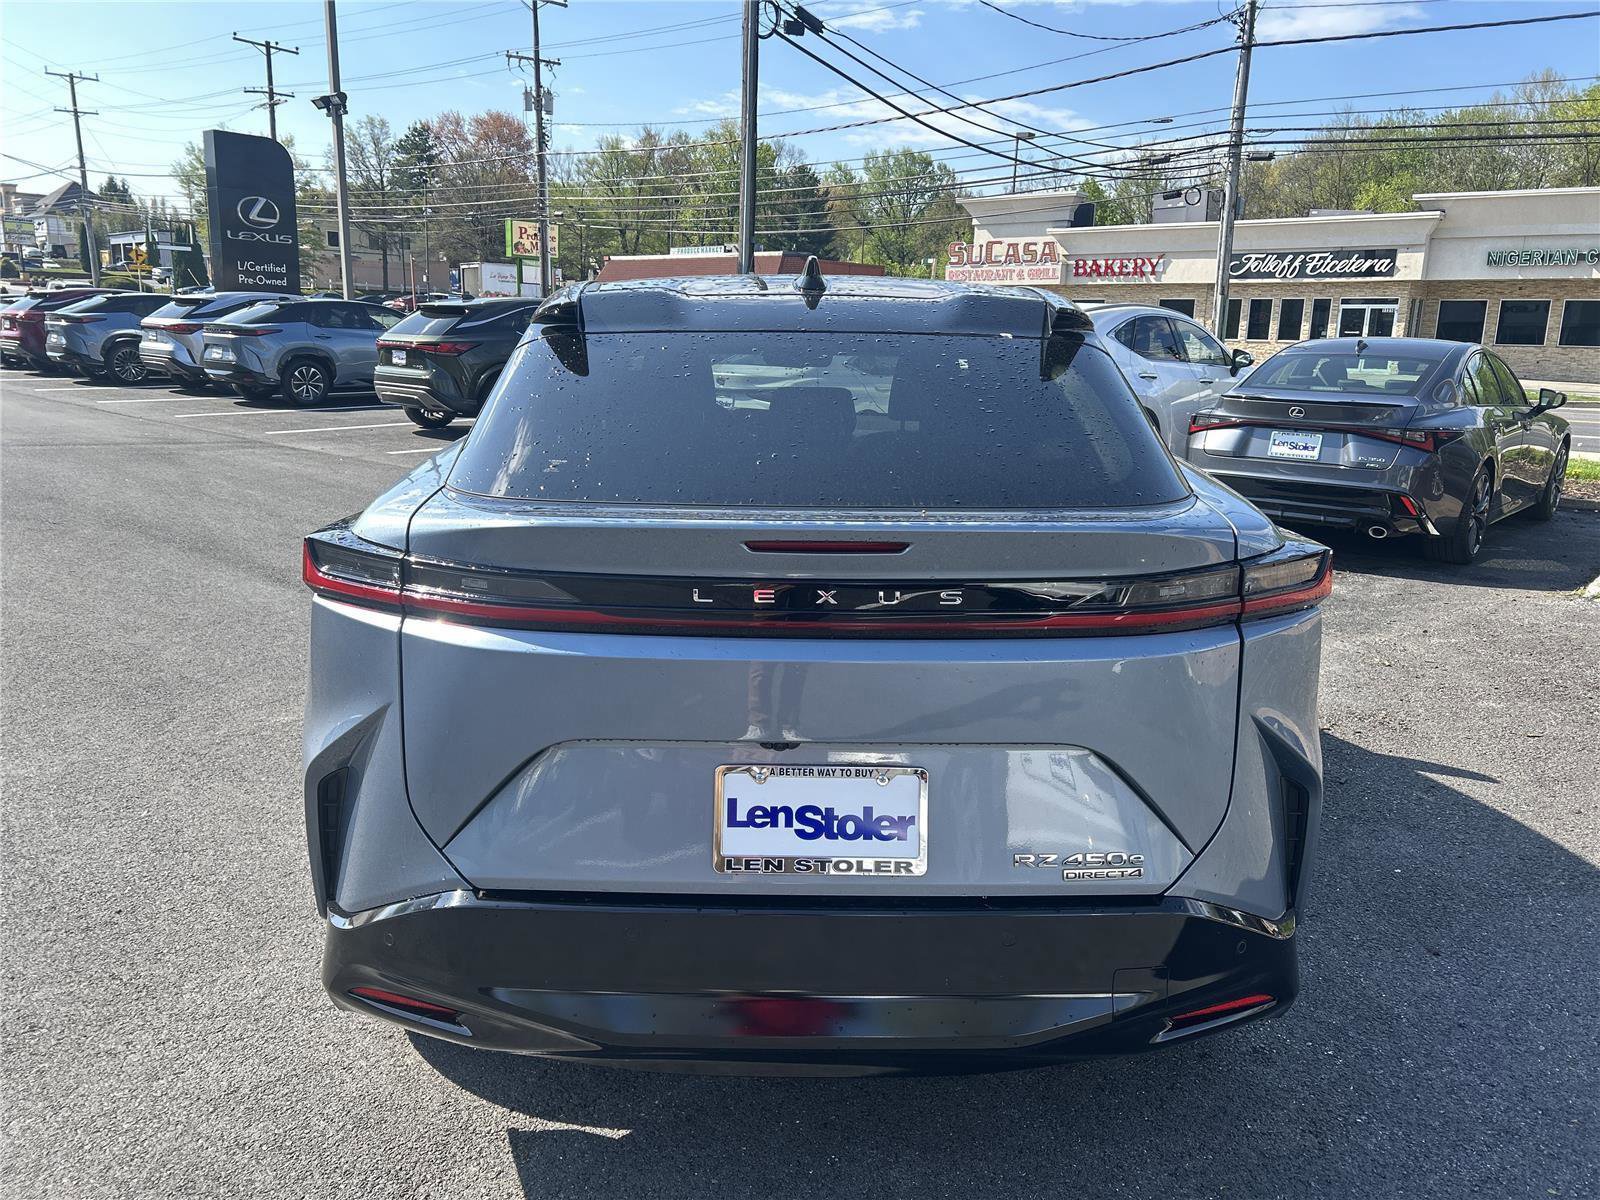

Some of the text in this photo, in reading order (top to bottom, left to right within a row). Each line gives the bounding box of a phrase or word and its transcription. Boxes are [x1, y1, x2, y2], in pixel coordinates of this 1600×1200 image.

[226, 230, 293, 244] LEXUS
[1305, 252, 1394, 275] Etcetera
[1486, 248, 1579, 267] NIGERIAN
[237, 260, 287, 273] L/Certified
[1073, 253, 1166, 279] BAKERY
[238, 273, 288, 286] Pre-Owned
[948, 268, 1015, 281] RESTAURANT
[1027, 267, 1059, 280] GRILL
[692, 587, 963, 605] LEXUS
[769, 767, 874, 778] A BETTER WAY TO BUY
[724, 858, 914, 875] LEN STOLER
[1013, 851, 1146, 868] RZ 450e
[1064, 868, 1144, 880] DIRECT4
